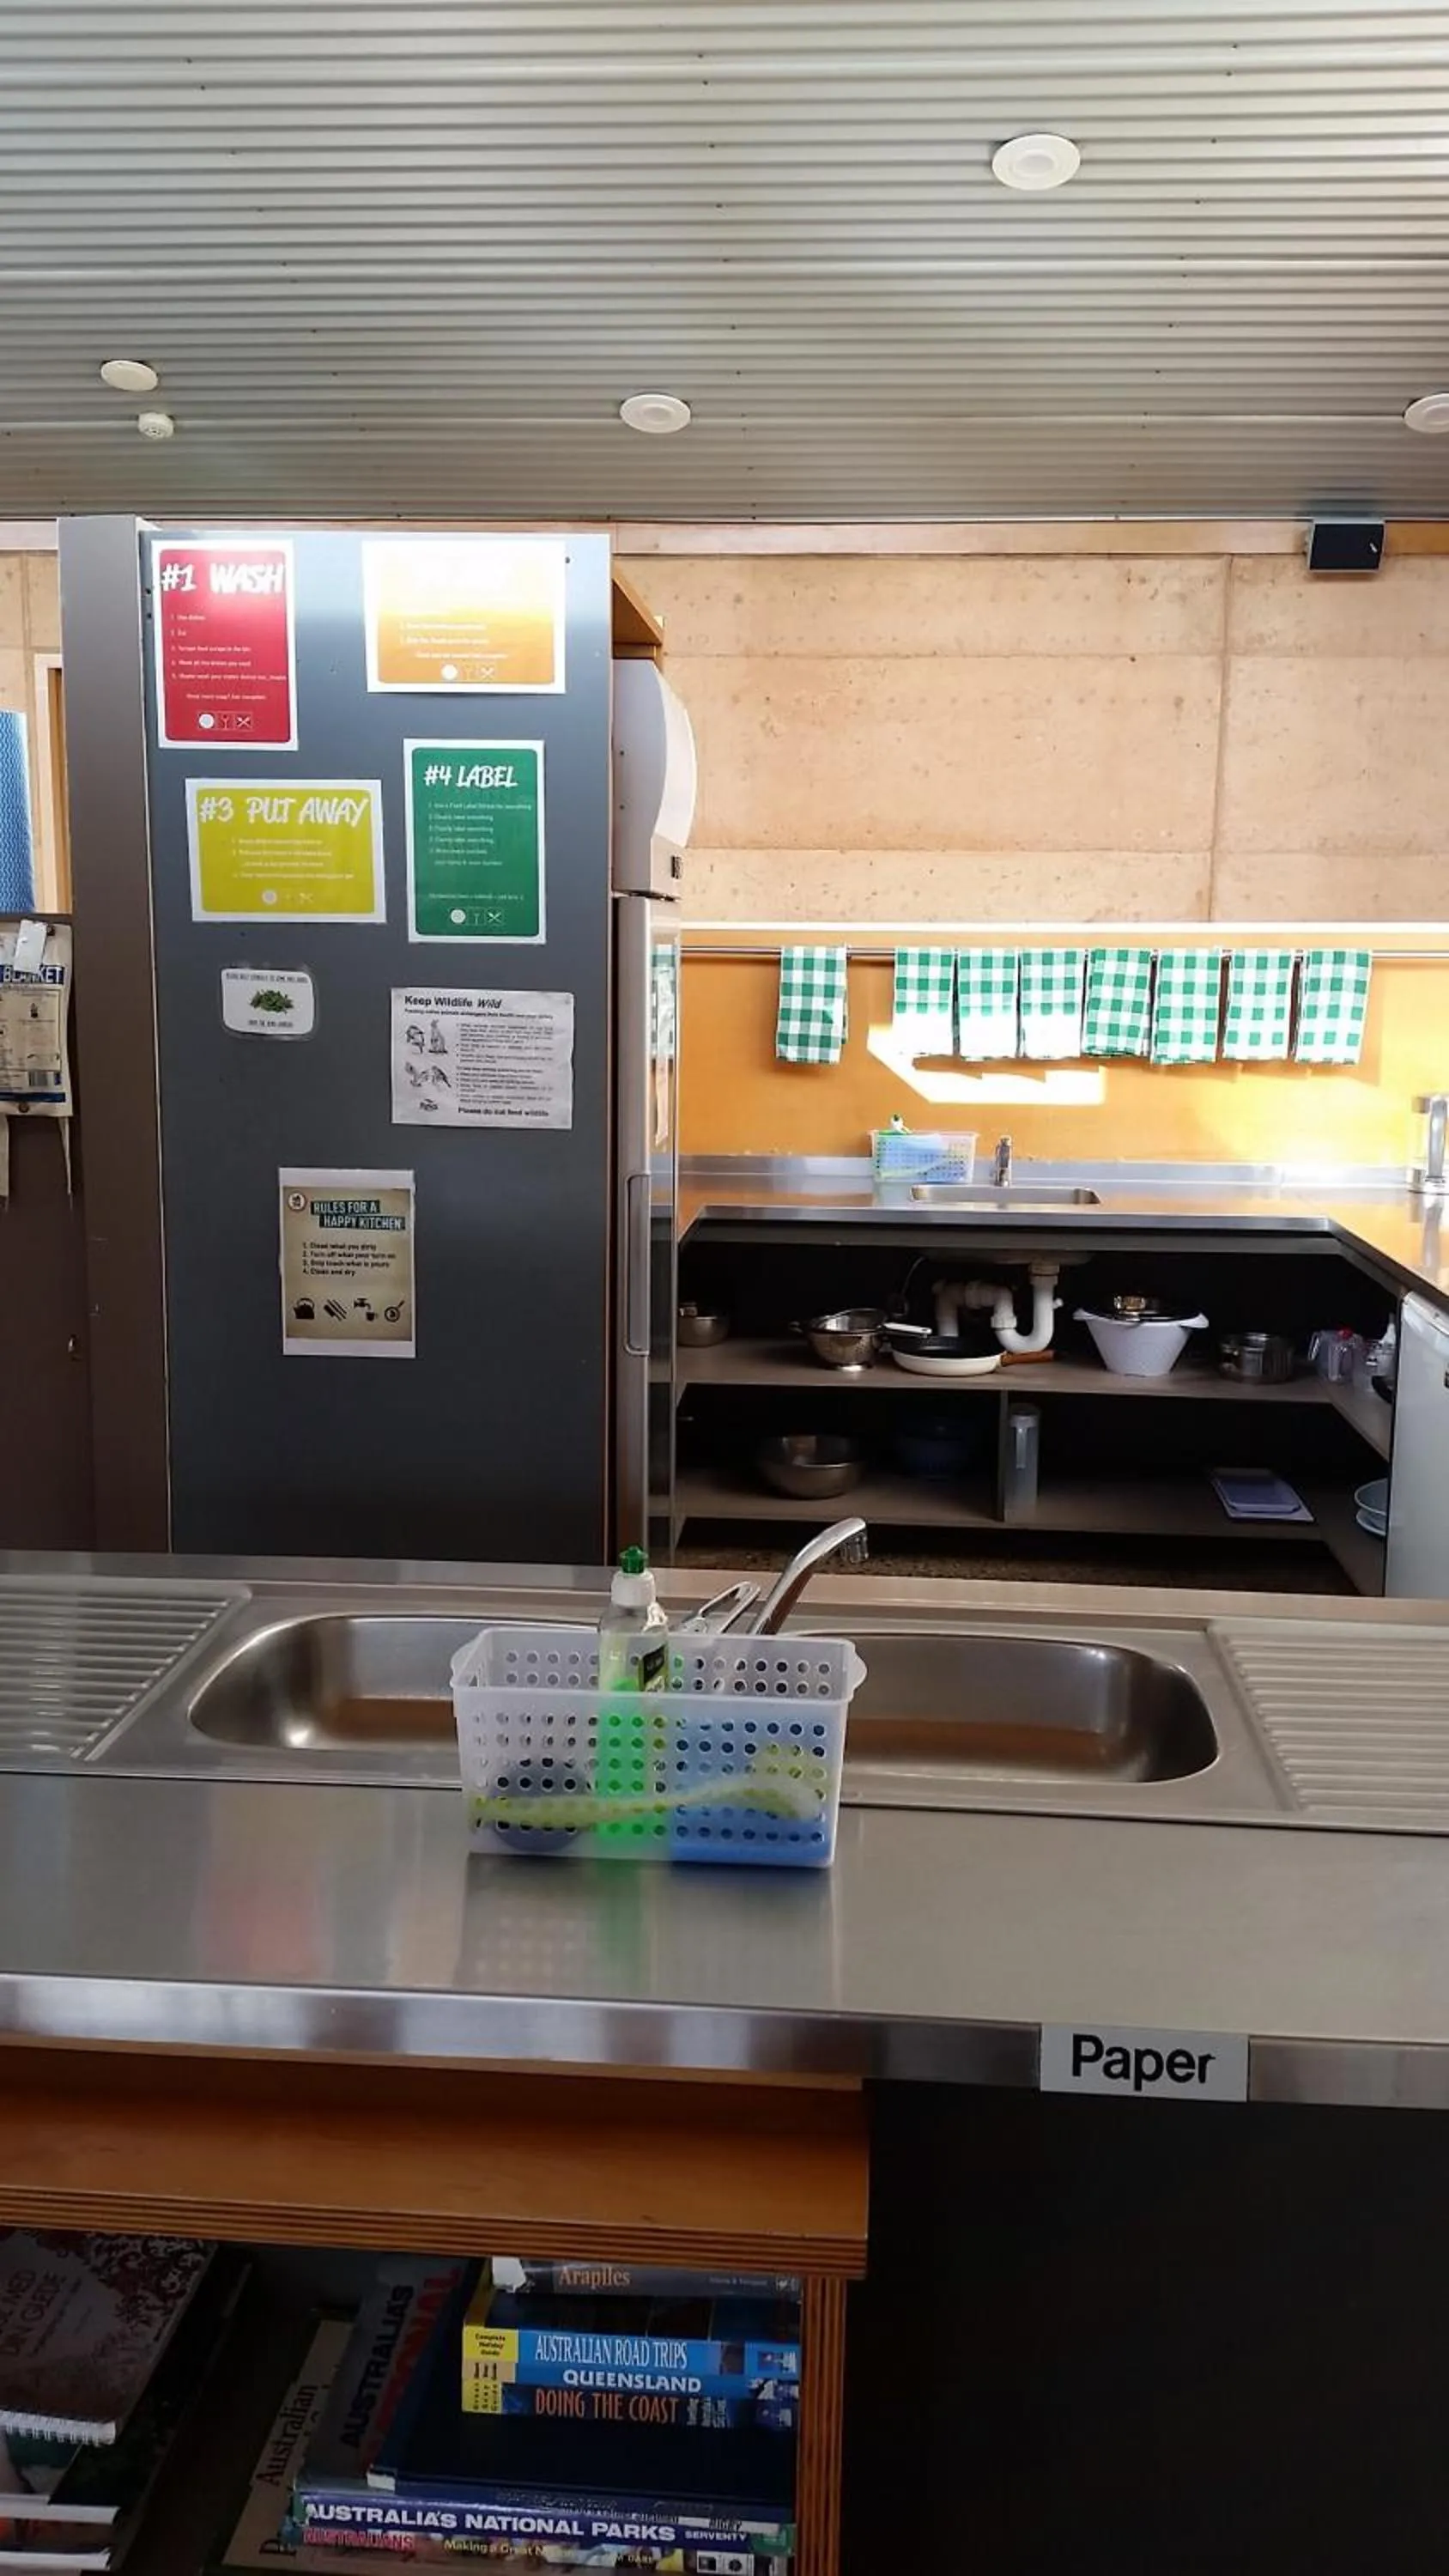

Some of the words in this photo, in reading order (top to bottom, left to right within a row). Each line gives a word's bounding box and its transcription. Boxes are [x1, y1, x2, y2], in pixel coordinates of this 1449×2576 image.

[161, 562, 198, 591] #1
[209, 562, 284, 594] WASH
[424, 765, 452, 787] #4
[456, 765, 518, 788] LABEL
[199, 797, 234, 823] #3
[246, 797, 296, 824] PUT
[299, 797, 368, 828] AWAY
[405, 995, 431, 1006] Keep
[434, 996, 472, 1007] Wildlife
[478, 999, 502, 1009] Wild
[313, 1201, 346, 1213] RULES
[348, 1201, 367, 1213] FOR
[370, 1201, 377, 1212] A
[324, 1215, 356, 1228] HAPPY
[359, 1217, 402, 1230] KITCHEN
[1072, 2032, 1216, 2092] Paper
[535, 2335, 611, 2365] AUSTRALIAN
[615, 2339, 649, 2367] ROAD
[652, 2341, 688, 2370] TRIPS
[563, 2369, 701, 2392] QUEENSLAND
[535, 2388, 585, 2418] DOING
[591, 2391, 624, 2421] THE
[627, 2396, 679, 2425] COAST
[257, 2384, 318, 2486] Australian
[306, 2503, 457, 2529] AUSTRALIA'S
[464, 2513, 585, 2536] NATIONAL
[591, 2522, 676, 2541] PARKS
[444, 2539, 488, 2555] Making
